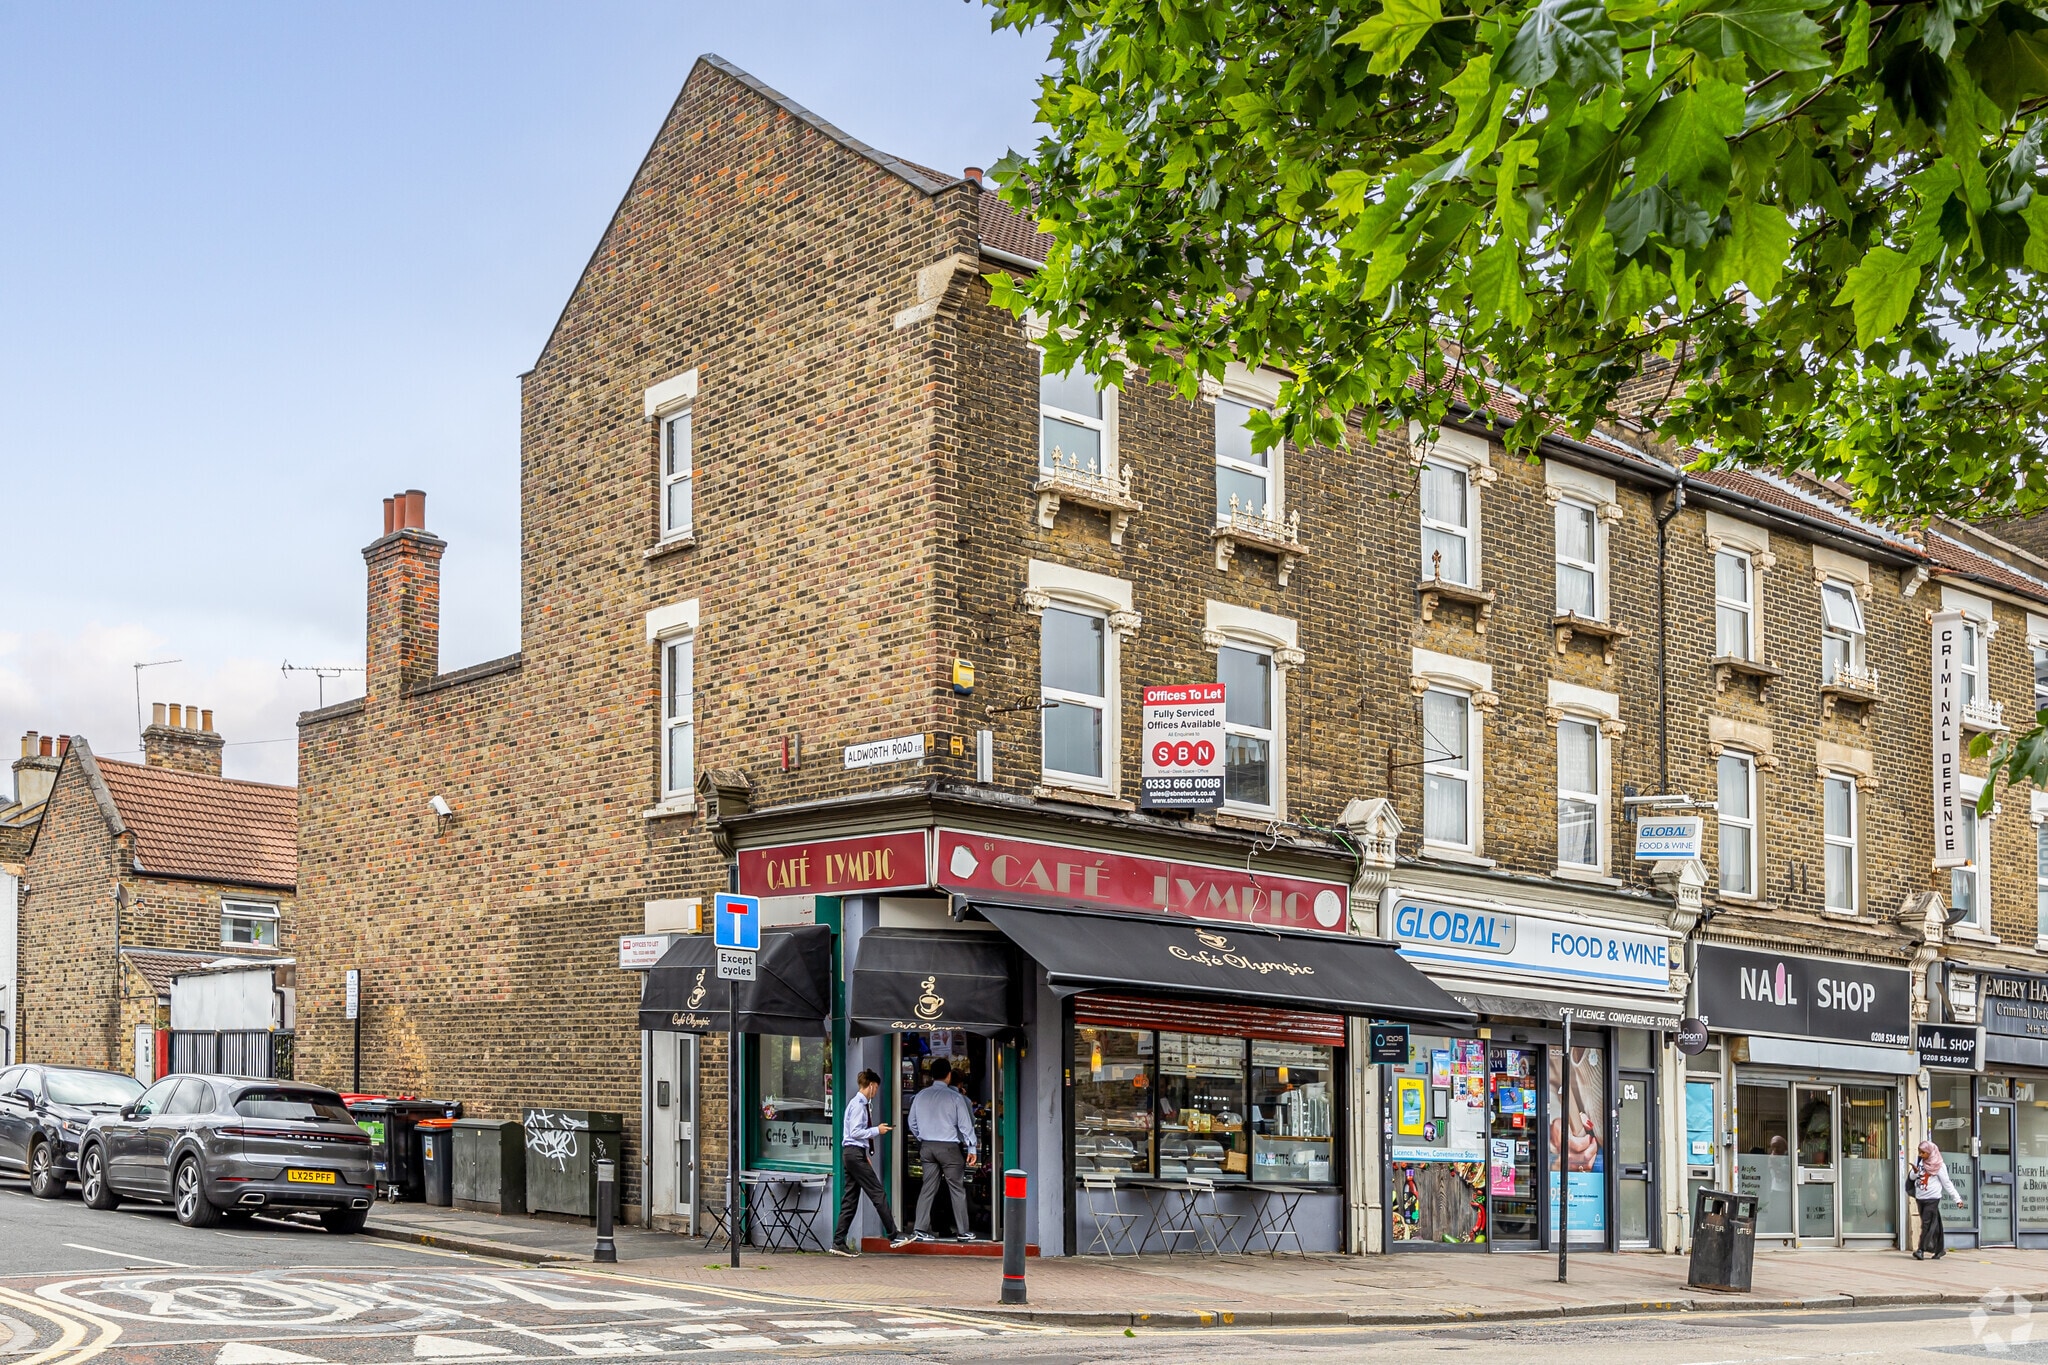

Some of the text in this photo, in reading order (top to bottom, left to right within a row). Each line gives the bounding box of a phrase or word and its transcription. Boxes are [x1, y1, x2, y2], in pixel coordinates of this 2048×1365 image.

[1147, 688, 1222, 701] Offices To Let
[1153, 708, 1215, 720] Fully Serviced
[1147, 719, 1221, 730] Offices Available
[1940, 630, 1955, 850] CRIMINAL DEFENCE
[847, 741, 922, 763] ALDWORTH ROAD E15
[1145, 778, 1221, 789] 0333 666 0088
[1149, 790, 1216, 798] sales@sbnetwork.co.uk
[983, 841, 995, 852] 61
[1639, 841, 1694, 849] FOOD & WINE
[766, 847, 896, 891] CAFÉ LYMPIC
[990, 853, 1311, 921] CAFÉ LYMPIC
[1551, 932, 1667, 968] FOOD & WINE
[720, 953, 753, 965] Except
[1168, 945, 1315, 976] Café Olympic
[722, 966, 751, 977] cycles
[1986, 976, 2027, 999] EMERY
[1817, 977, 1876, 1013] SHOP
[1996, 1001, 2030, 1018] Criminal
[1608, 1011, 1655, 1026] CONVENIENCE
[1656, 1016, 1679, 1028] STORE
[1677, 1030, 1703, 1043] ploom
[1870, 1031, 1910, 1045] 0208 534 9997
[1949, 1038, 1976, 1052] SHOP
[1922, 1053, 1970, 1064] 0208 534 9997
[1624, 1084, 1639, 1100] 63a
[287, 1134, 336, 1142] PORSCHE
[765, 1128, 834, 1150] Café lymp
[1432, 1149, 1464, 1158] Convenience
[1464, 1149, 1479, 1158] Store
[291, 1171, 332, 1182] LX25 PFF
[2017, 1165, 2038, 1177] EMERY
[1700, 1222, 1725, 1233] LITTER
